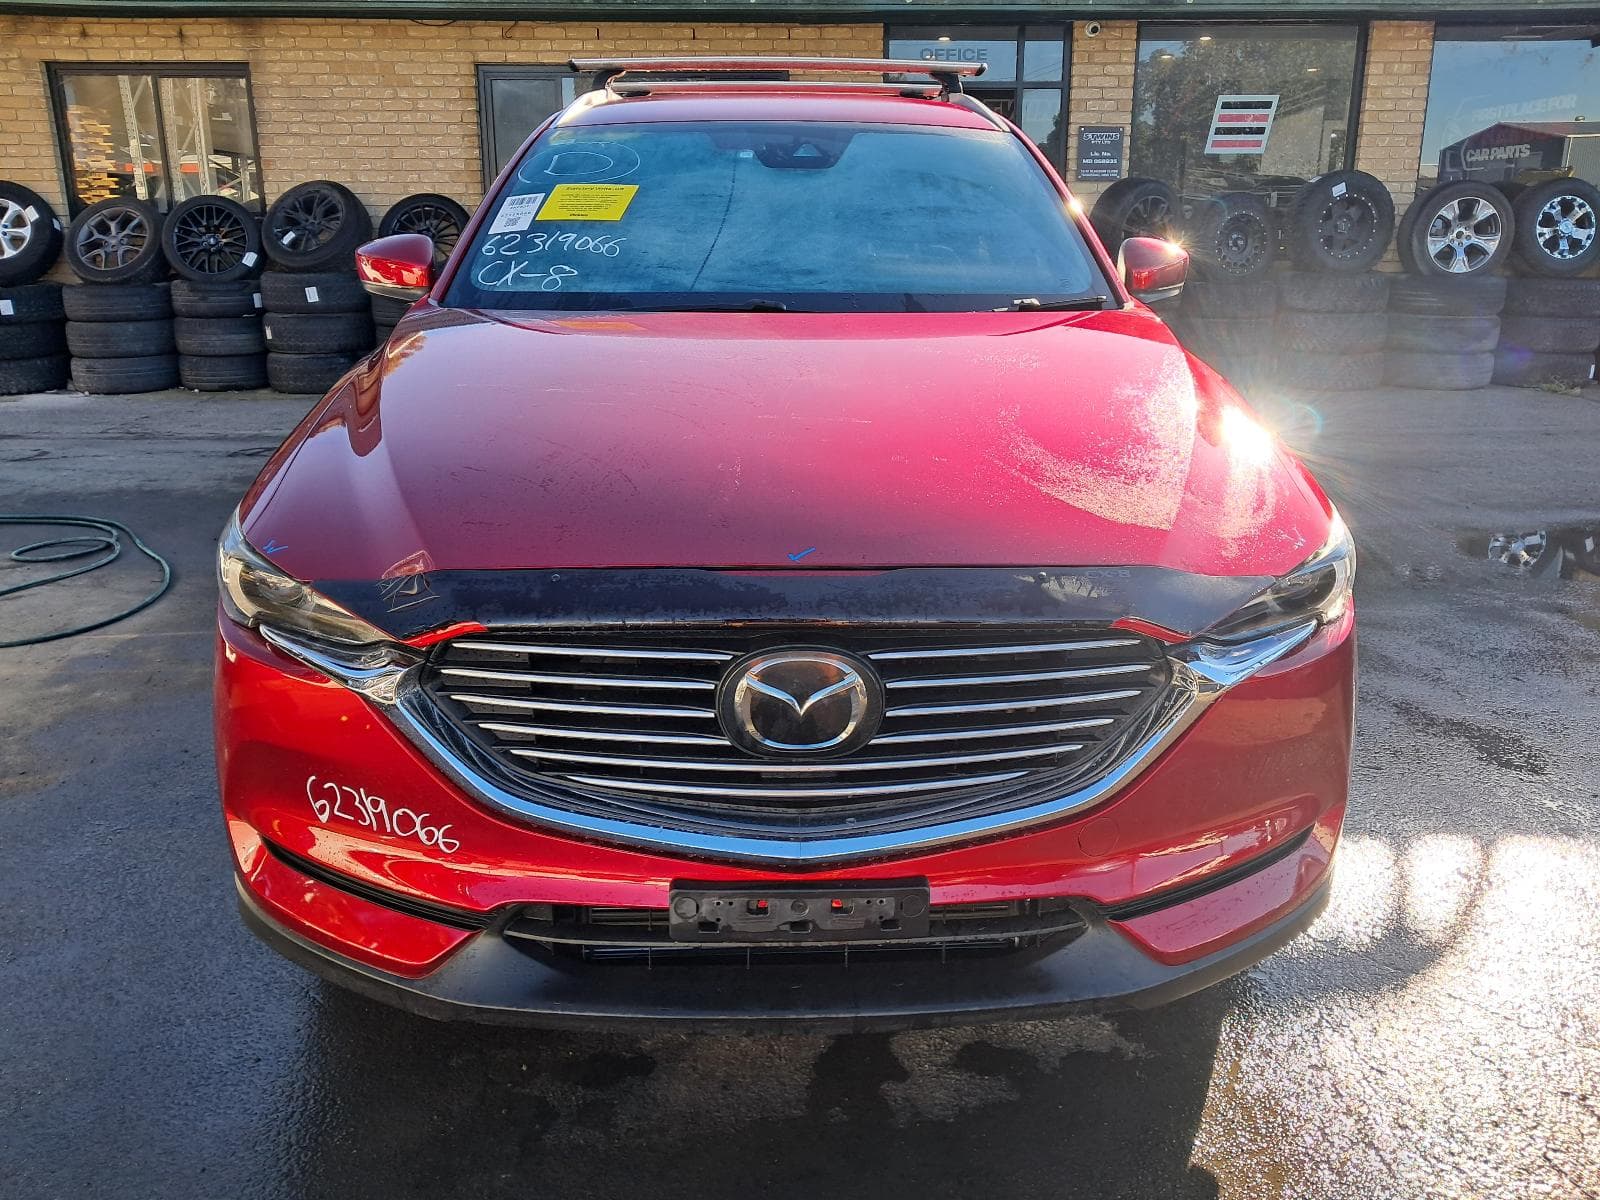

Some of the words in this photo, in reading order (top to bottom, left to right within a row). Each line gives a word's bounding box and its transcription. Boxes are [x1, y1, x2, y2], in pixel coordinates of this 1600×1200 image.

[920, 48, 987, 61] OFFICE
[1466, 148, 1490, 162] CAR
[1490, 144, 1531, 161] PARTS
[482, 231, 627, 258] 62319066
[477, 260, 578, 291] CX-8
[306, 775, 460, 854] 62319066
